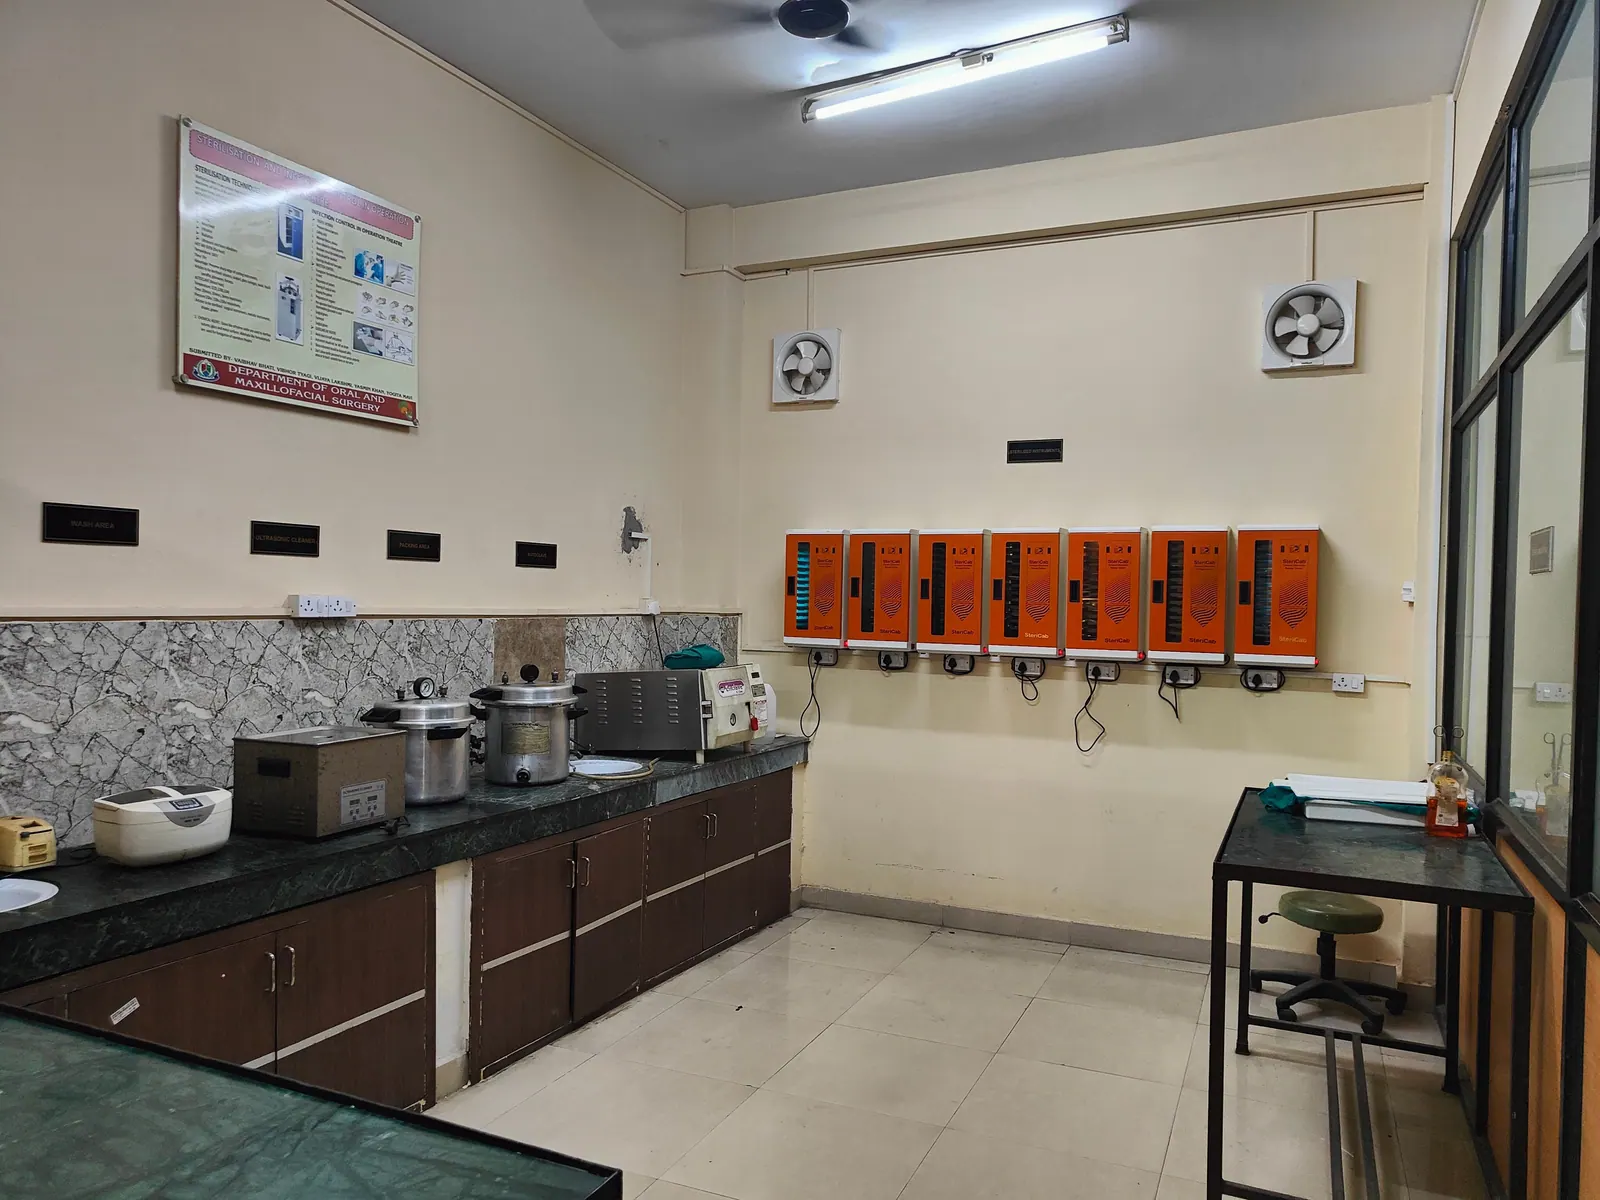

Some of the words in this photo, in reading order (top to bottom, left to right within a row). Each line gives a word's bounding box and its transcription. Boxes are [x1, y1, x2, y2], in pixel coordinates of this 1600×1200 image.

[197, 135, 260, 167] STERILISATION
[194, 164, 231, 183] STERILISATION
[311, 208, 335, 222] INFECTION
[335, 215, 356, 230] CONTROL
[361, 227, 386, 241] OPERATION
[189, 347, 222, 359] SUBMITTED
[228, 364, 309, 388] DEPARTMENT
[312, 382, 329, 392] OF
[331, 386, 361, 399] ORAL
[363, 393, 385, 403] AND
[235, 377, 329, 403] MAXILLOFACIAL
[332, 396, 381, 412] SURGERY
[70, 520, 93, 529] WASH
[94, 521, 115, 529] AREA
